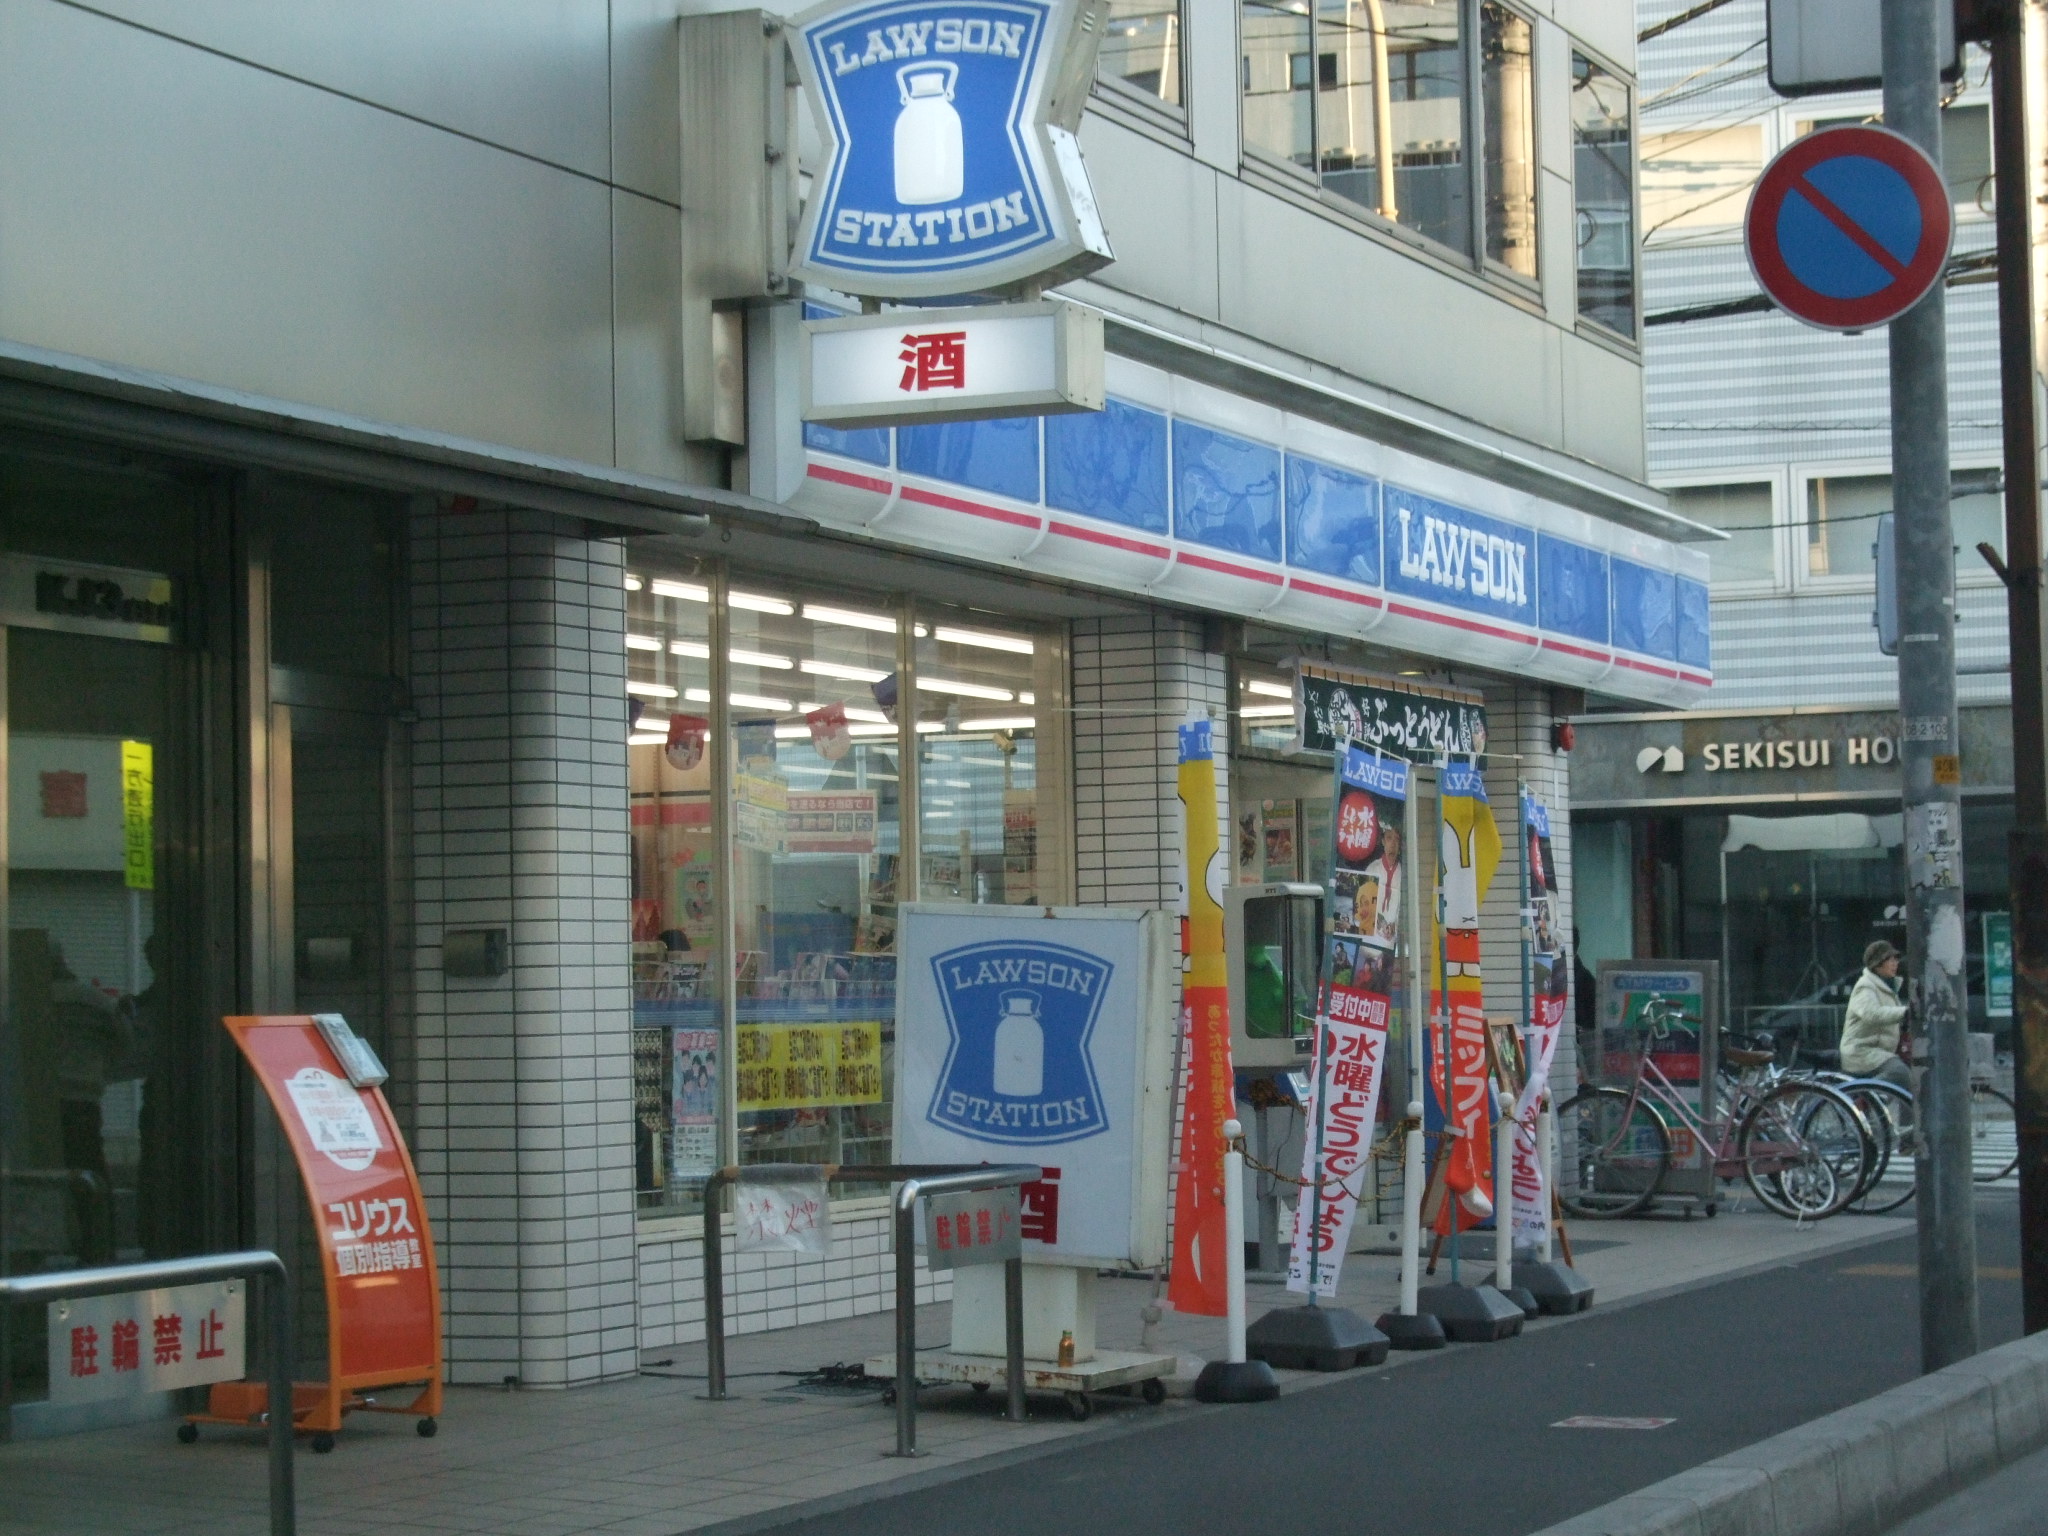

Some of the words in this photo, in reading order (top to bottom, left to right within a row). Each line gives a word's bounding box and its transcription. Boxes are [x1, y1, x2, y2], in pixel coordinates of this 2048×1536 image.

[830, 18, 1025, 76] LAWSON
[834, 191, 1029, 247] STATION
[898, 331, 966, 391] 酒
[1399, 507, 1527, 606] LAWSON
[1344, 756, 1406, 794] LAWSO
[1702, 739, 1829, 771] SEKISUI
[952, 959, 1094, 996] LAWSON
[1329, 991, 1371, 1022] 受付中
[946, 1091, 1089, 1127] STATION
[1306, 1032, 1379, 1253] 水曜どうでしょう
[328, 1198, 415, 1241] ユリウス
[336, 1240, 411, 1276] 個別指導
[69, 1308, 225, 1379] 駐輪禁止
